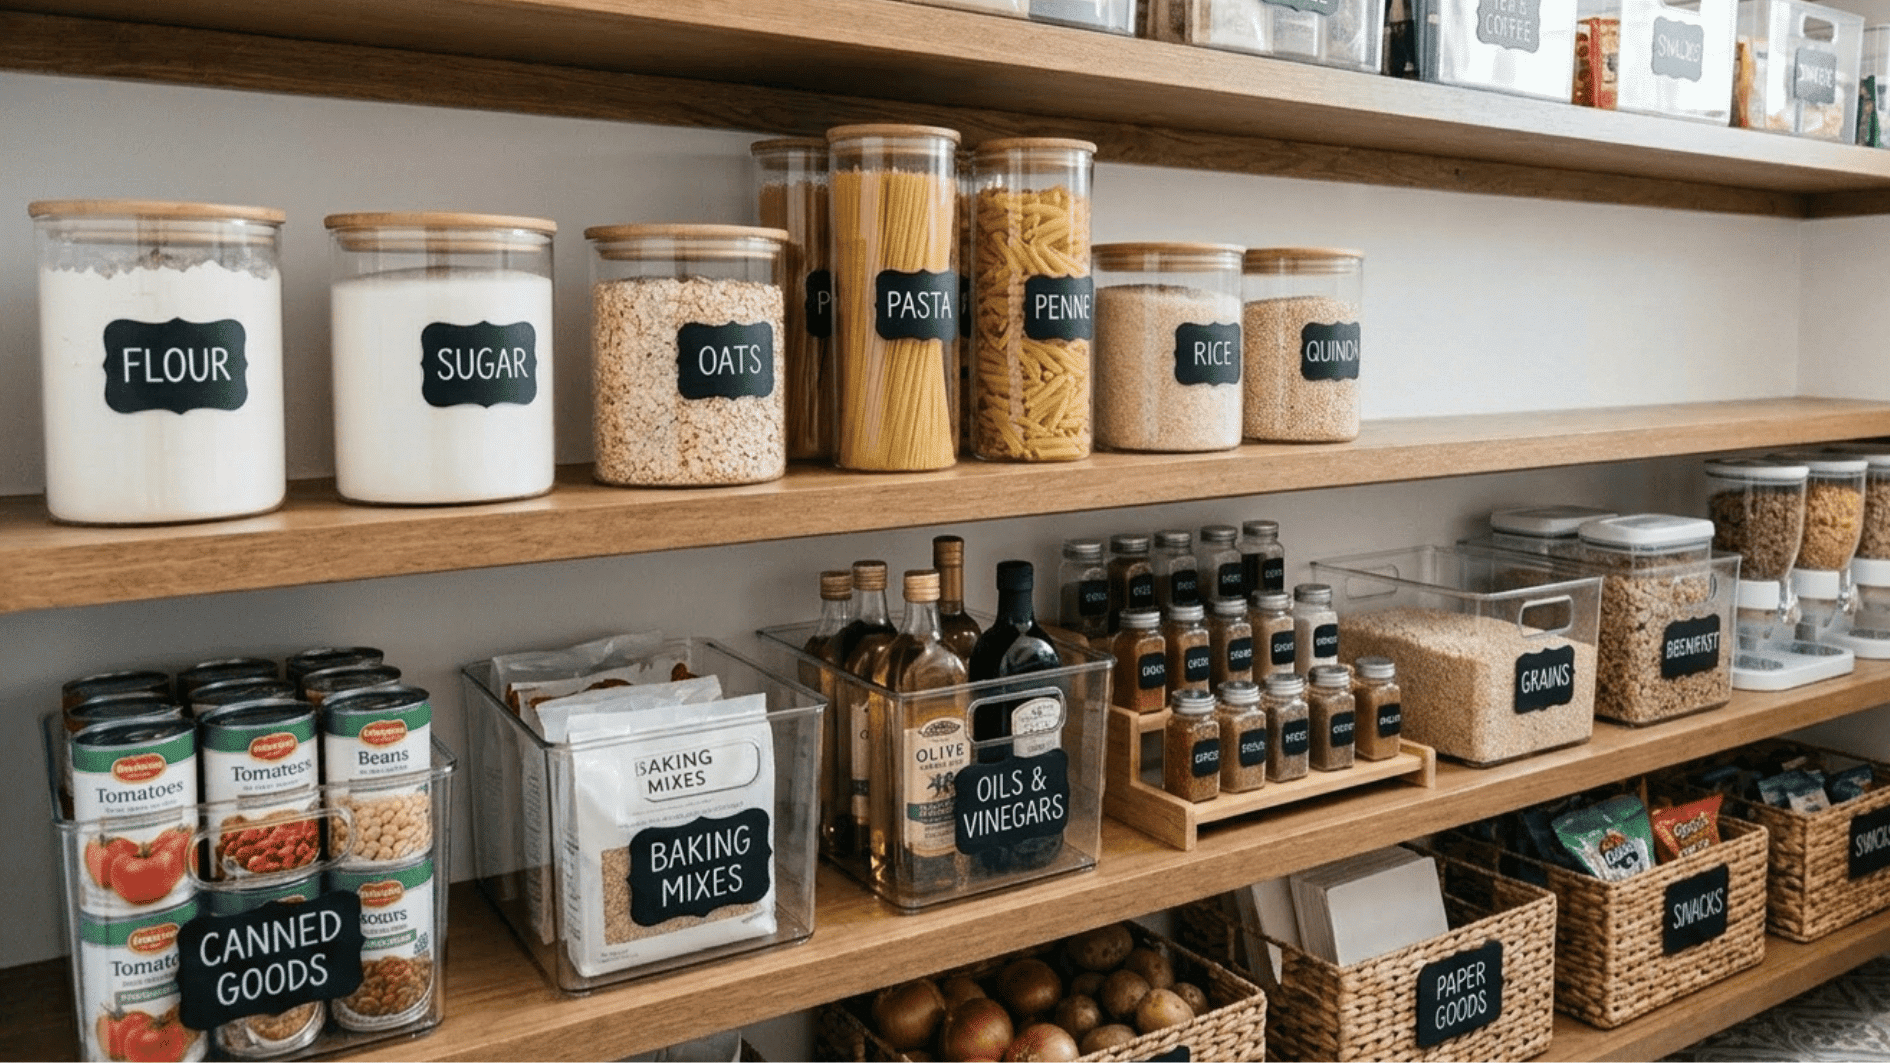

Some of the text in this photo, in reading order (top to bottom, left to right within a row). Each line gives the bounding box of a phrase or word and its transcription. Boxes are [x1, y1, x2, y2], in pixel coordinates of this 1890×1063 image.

[887, 290, 952, 319] PASTA
[1035, 293, 1090, 320] PENNE
[123, 347, 231, 383] FLOUR
[437, 347, 529, 380] SUGAR
[698, 344, 762, 375] OATS
[1194, 341, 1231, 366] RICE
[1521, 663, 1570, 694] GRAINS
[358, 749, 409, 766] Beans
[916, 742, 964, 763] OLIVE
[95, 780, 184, 804] Tomatoes
[648, 770, 706, 794] MIXES
[976, 766, 1047, 803] OILS &
[963, 793, 1064, 839] VINEGARS
[651, 825, 750, 873] BAKING
[662, 863, 743, 908] MIXES
[200, 910, 342, 966] CANNED
[217, 953, 328, 1006] GOODS
[1436, 961, 1486, 1000] PAPER
[1435, 989, 1487, 1030] GOODS
